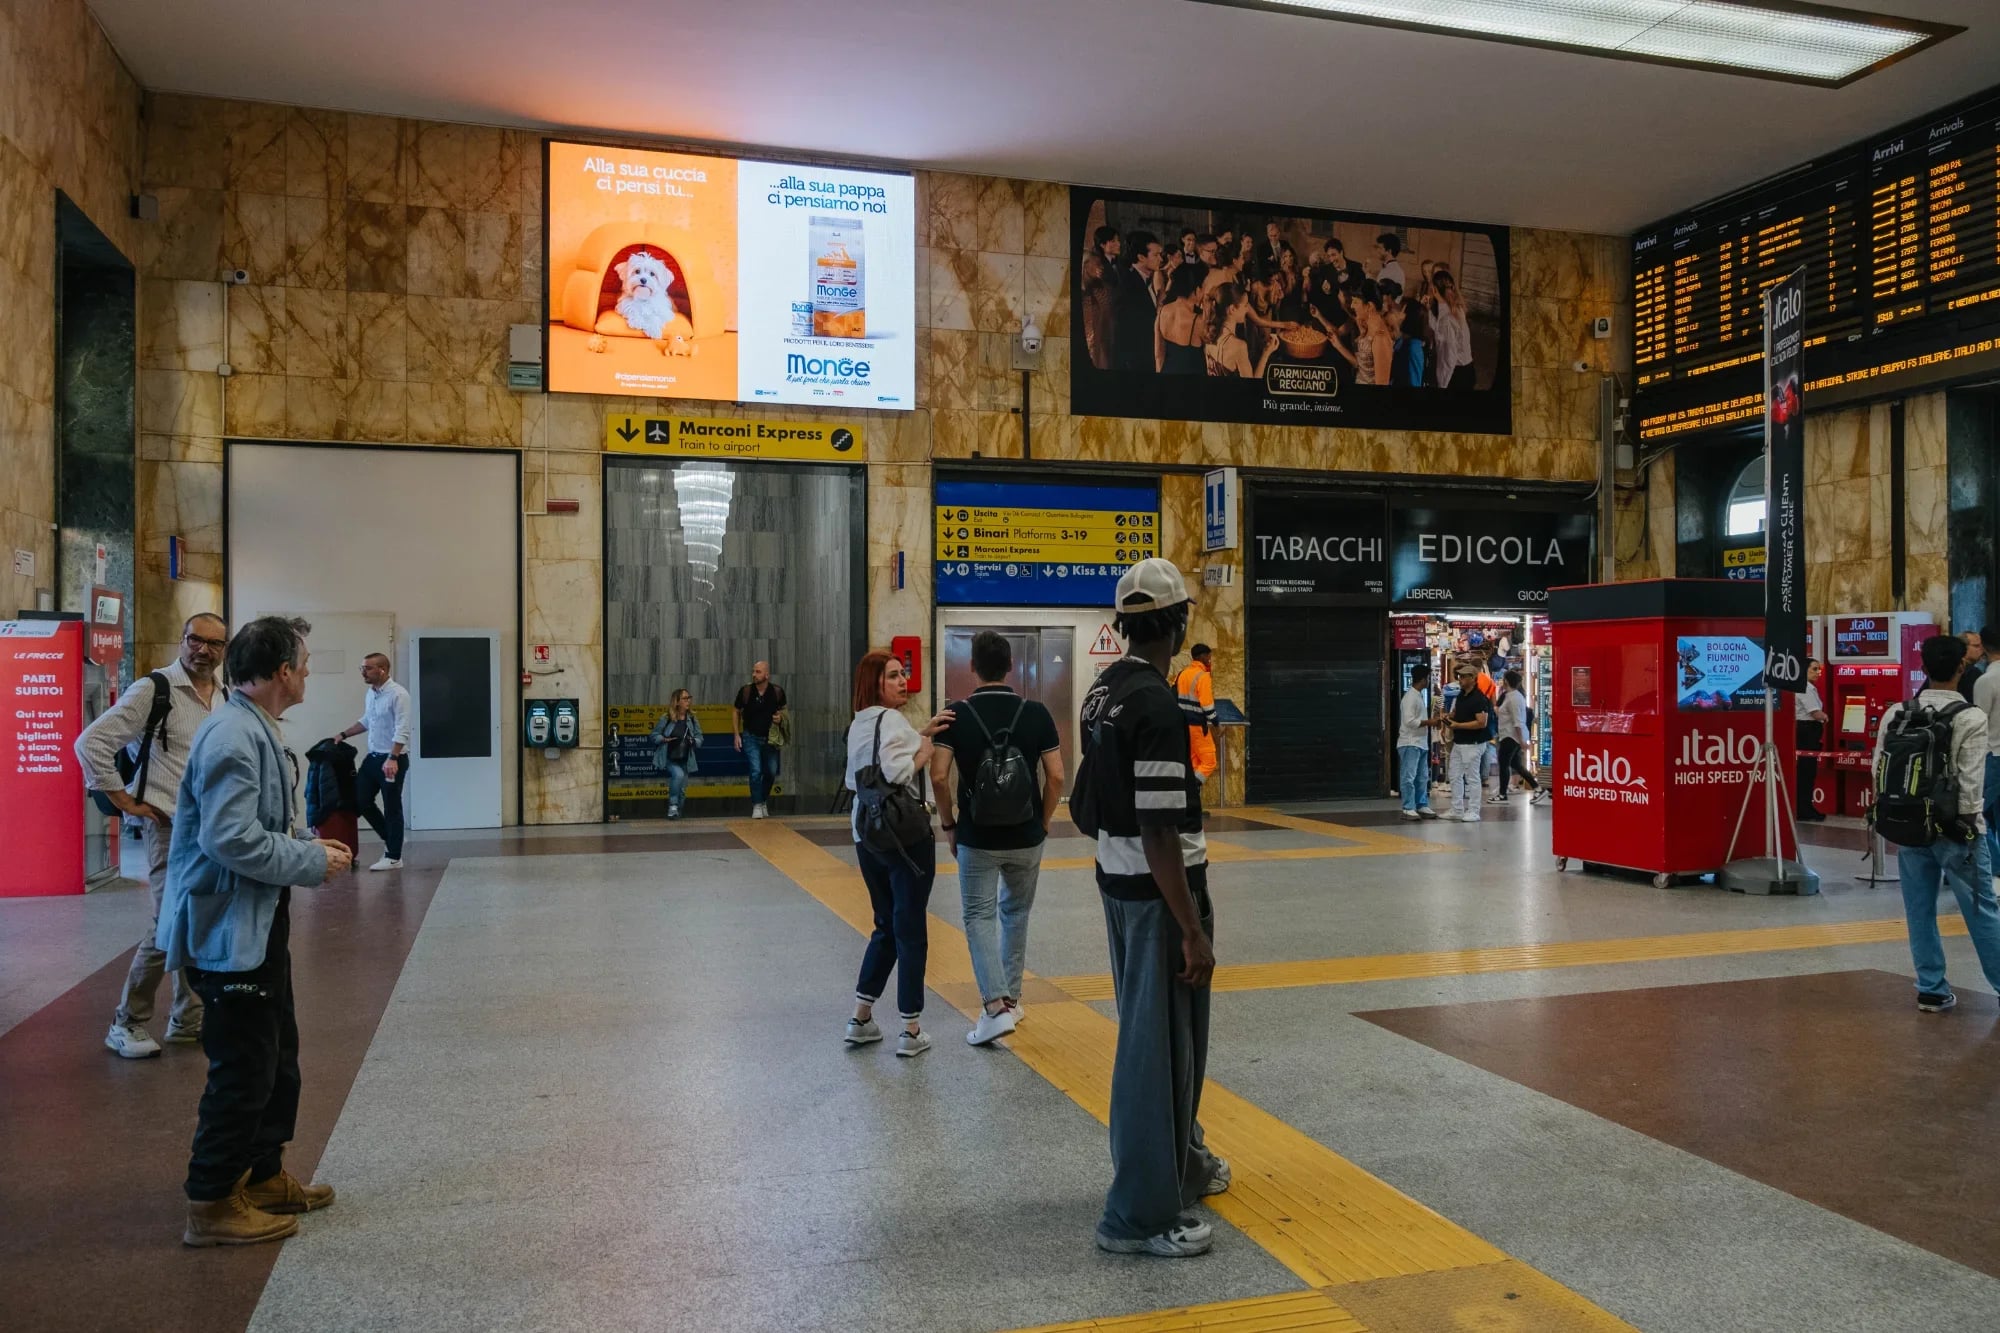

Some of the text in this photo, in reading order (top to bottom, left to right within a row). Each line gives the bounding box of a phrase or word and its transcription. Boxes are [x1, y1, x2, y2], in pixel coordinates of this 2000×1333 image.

[1929, 117, 1964, 140] Arrivals
[1873, 140, 1904, 161] Arrivi
[584, 157, 707, 183] Alla sua cuccia
[597, 177, 694, 198] ci pensi tu...
[770, 176, 885, 199] ...alla sua pappa
[768, 191, 887, 214] ci pensiamo noi
[1674, 221, 1698, 237] Arrivals
[1635, 235, 1657, 251] Arrivi
[1816, 375, 1845, 389] NATIONAL
[1846, 368, 1868, 382] STRIKE
[1870, 366, 1880, 376] BY
[1881, 360, 1906, 375] GRUPPO
[1907, 358, 1917, 369] FS
[1954, 343, 1976, 358] ITALO
[1977, 340, 1992, 353] AND
[1273, 368, 1331, 381] PARMIGIANO
[1280, 380, 1326, 391] REGGIANO
[1263, 399, 1278, 410] Più
[1280, 401, 1313, 412] grande,
[1705, 403, 1721, 413] COULD
[1722, 401, 1729, 410] BE
[1731, 396, 1753, 408] DELAYED
[1754, 393, 1762, 403] OR
[1702, 418, 1709, 426] LA
[679, 420, 823, 442] Marconi Express
[679, 438, 760, 454] Train to airport
[1780, 473, 1789, 527] CLIENTI
[974, 509, 998, 517] Uscita
[974, 528, 1088, 540] Binari Platforms 3-19
[1010, 545, 1040, 554] Express
[1256, 535, 1383, 563] TABACCHI
[1418, 533, 1565, 566] EDICOLA
[974, 563, 1002, 571] Servizi
[1072, 565, 1130, 576] Kiss & Rid
[1406, 588, 1453, 600] LIBRERIA
[1517, 590, 1549, 601] GIOCA
[1837, 632, 1861, 642] BIGLIETTI
[1866, 632, 1887, 641] TICKETS
[1707, 643, 1747, 651] BOLOGNA
[1707, 653, 1750, 662] FIUMICINO
[1719, 664, 1740, 674] 27,90
[22, 674, 56, 683] PARTI
[15, 686, 63, 696] SUBITO!
[15, 710, 63, 719] Qui trovi
[32, 721, 54, 729] tuoi
[16, 731, 62, 742] biglietti:
[18, 743, 61, 752] è sicuro,
[19, 753, 60, 763] è facile,
[17, 764, 63, 773] è veloce!
[1675, 770, 1781, 785] HIGH SPEED TRAN
[1563, 785, 1649, 805] HIGH SPEED TRAIN
